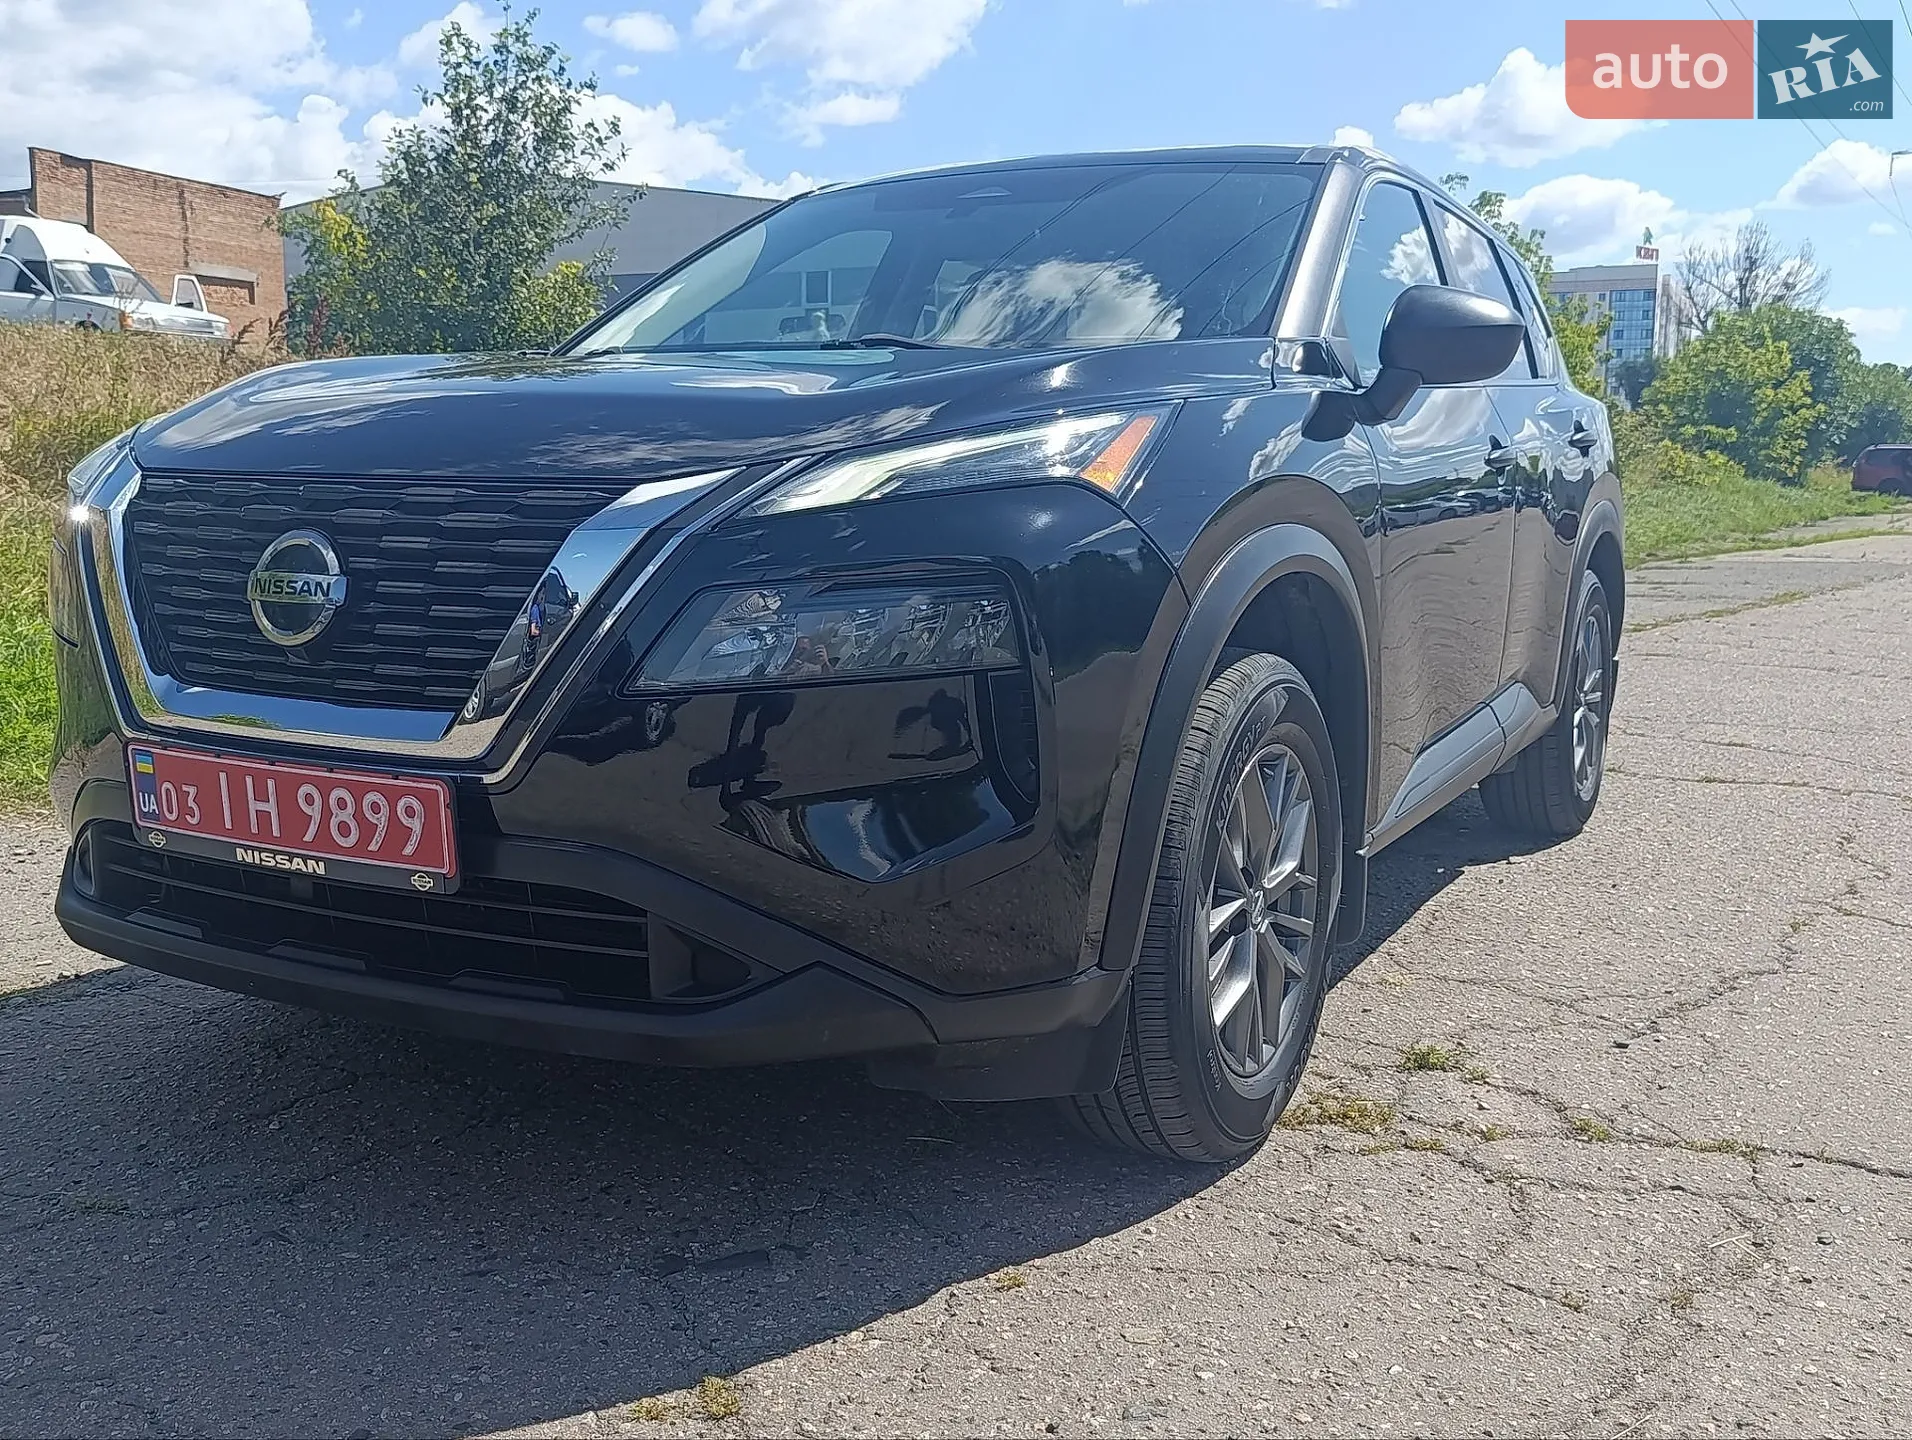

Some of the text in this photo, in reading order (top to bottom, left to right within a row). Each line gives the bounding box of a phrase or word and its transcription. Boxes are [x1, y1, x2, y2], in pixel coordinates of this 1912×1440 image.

[255, 578, 331, 597] NISSAN
[139, 792, 160, 815] UA
[161, 781, 201, 826] 03
[297, 783, 425, 856] 9899
[236, 848, 326, 876] NISSAN
